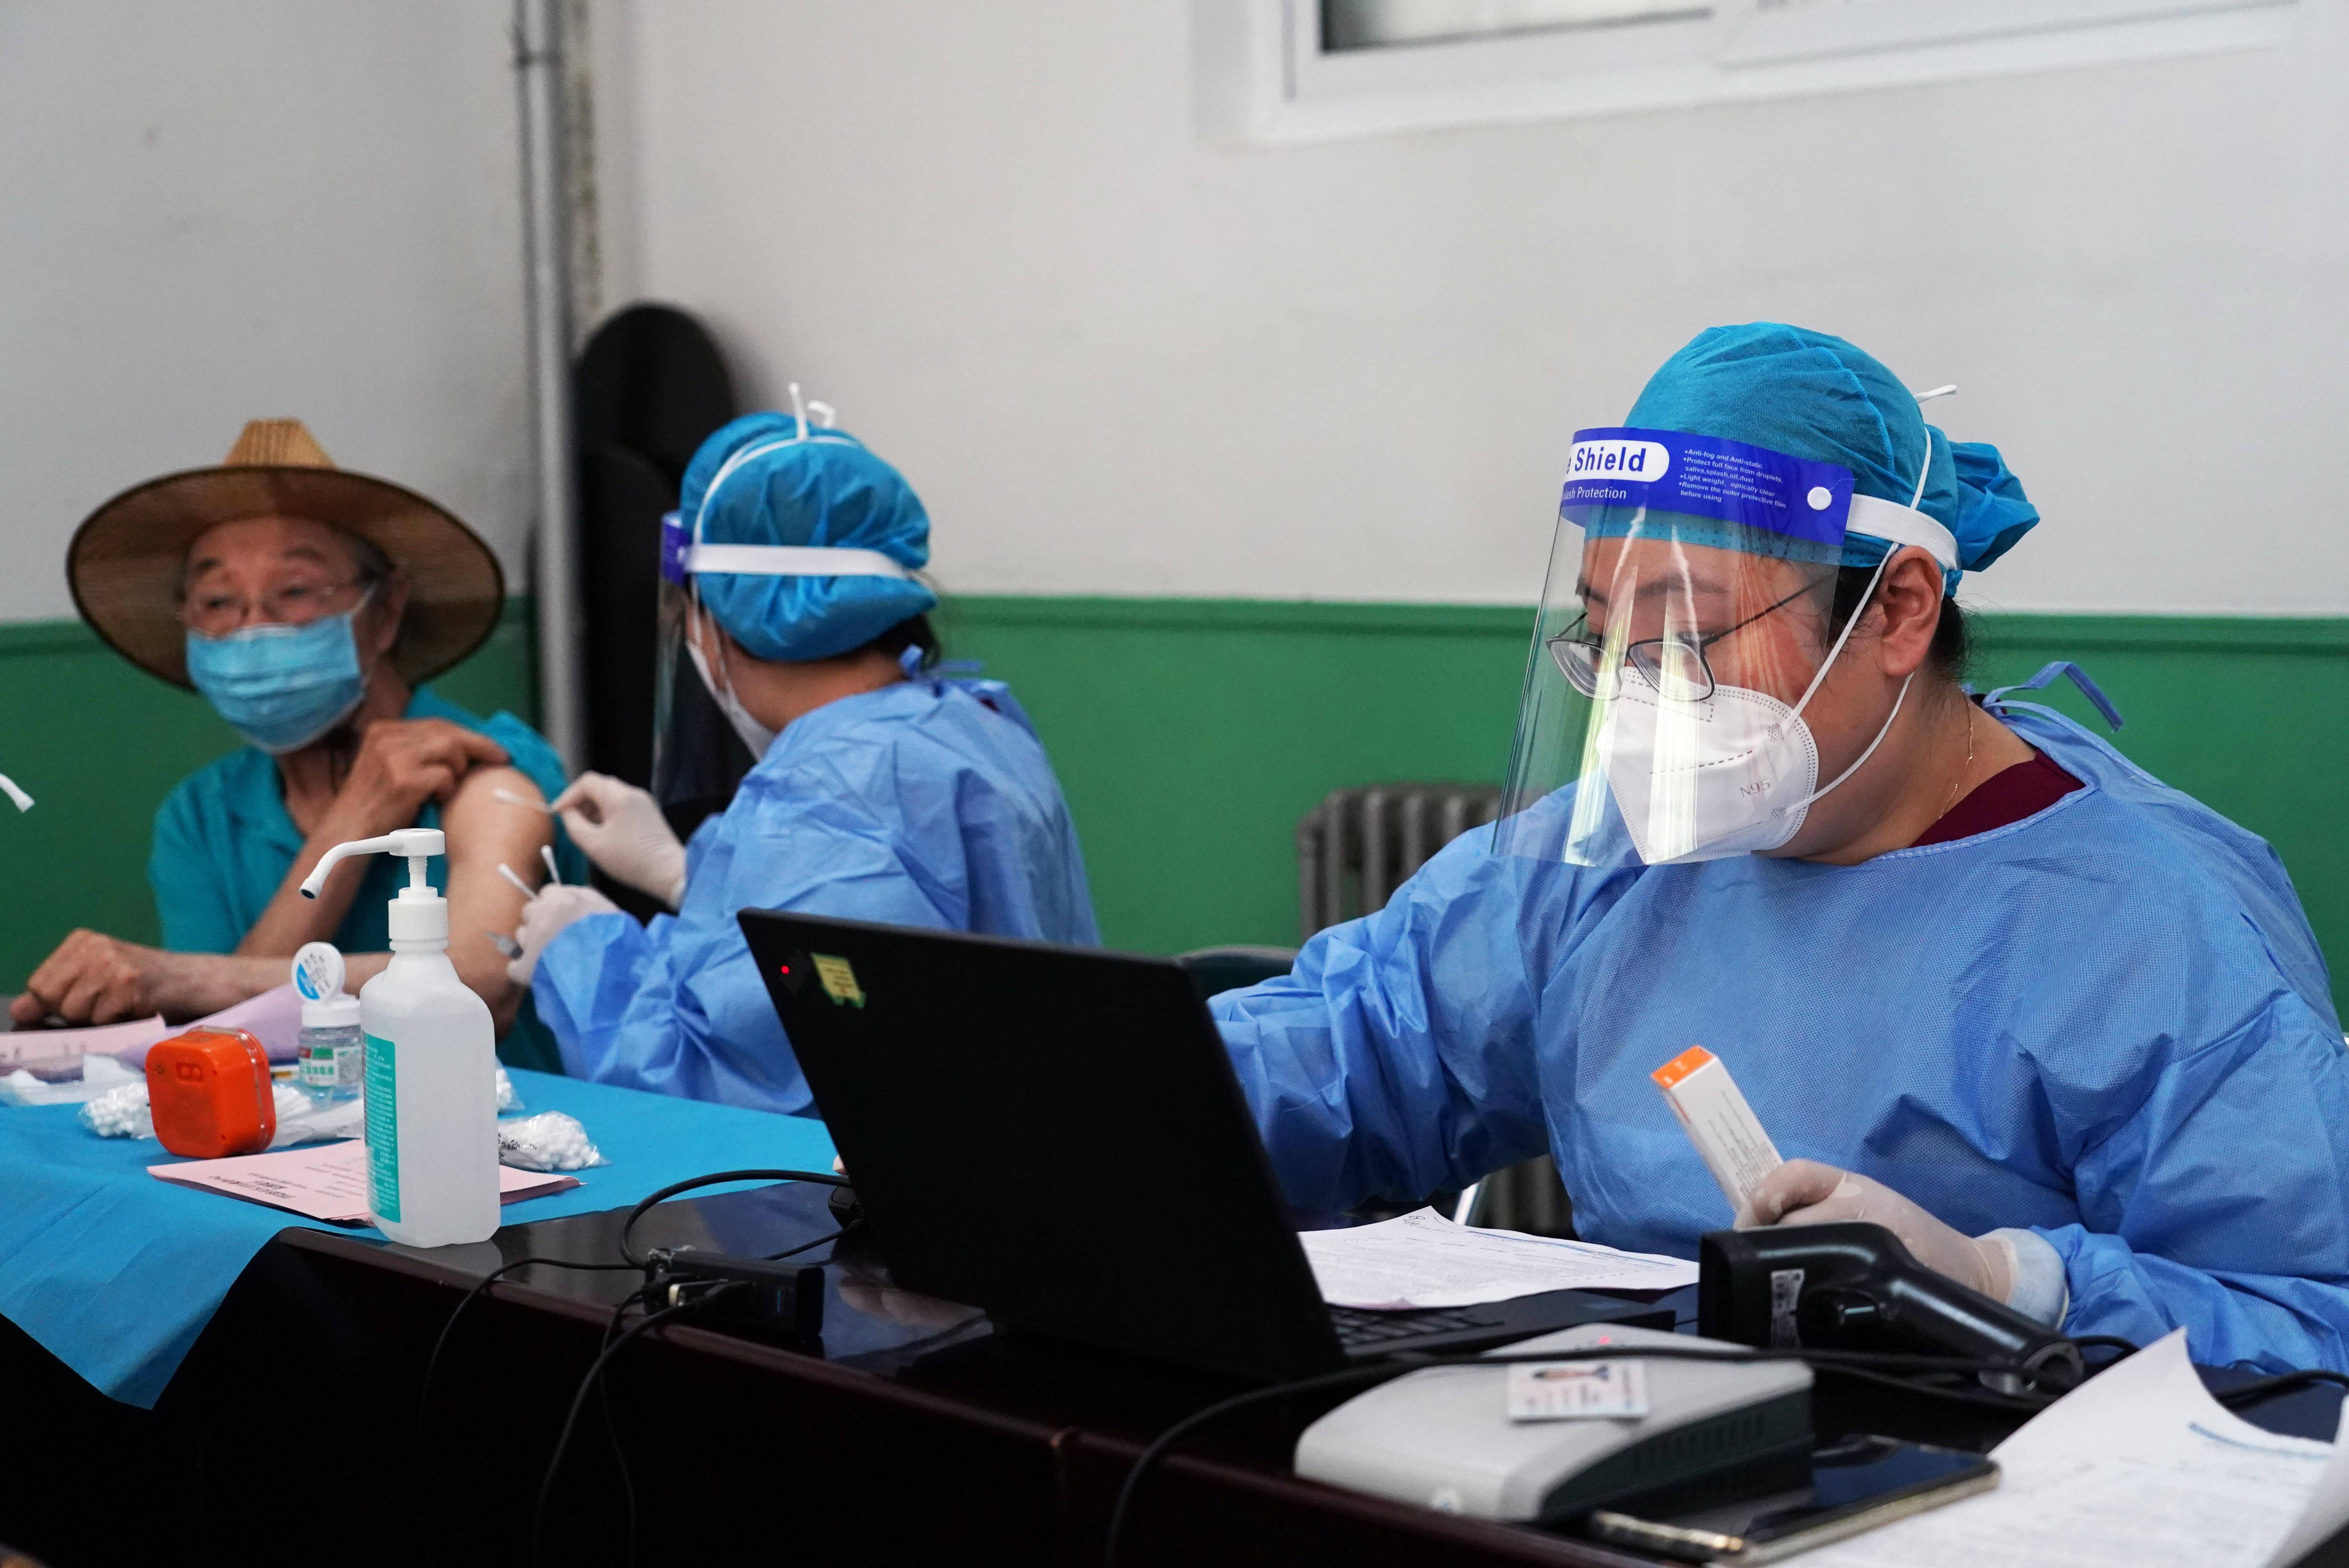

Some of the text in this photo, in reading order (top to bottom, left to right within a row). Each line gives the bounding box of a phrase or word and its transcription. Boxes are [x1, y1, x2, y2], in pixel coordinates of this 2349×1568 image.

[1575, 446, 1646, 472] Shield
[1687, 457, 1711, 466] Protect
[1740, 466, 1754, 475] from
[1688, 449, 1715, 460] Anti-fog
[1730, 456, 1763, 469] Anti-static
[1577, 486, 1627, 499] Protection
[1684, 473, 1700, 481] Light
[1730, 482, 1758, 494] optically
[1759, 489, 1775, 497] clear
[1680, 489, 1722, 503] before using
[1682, 481, 1709, 491] Remove
[1741, 493, 1773, 505] protective
[1774, 500, 1786, 509] film
[1740, 779, 1770, 798] N95
